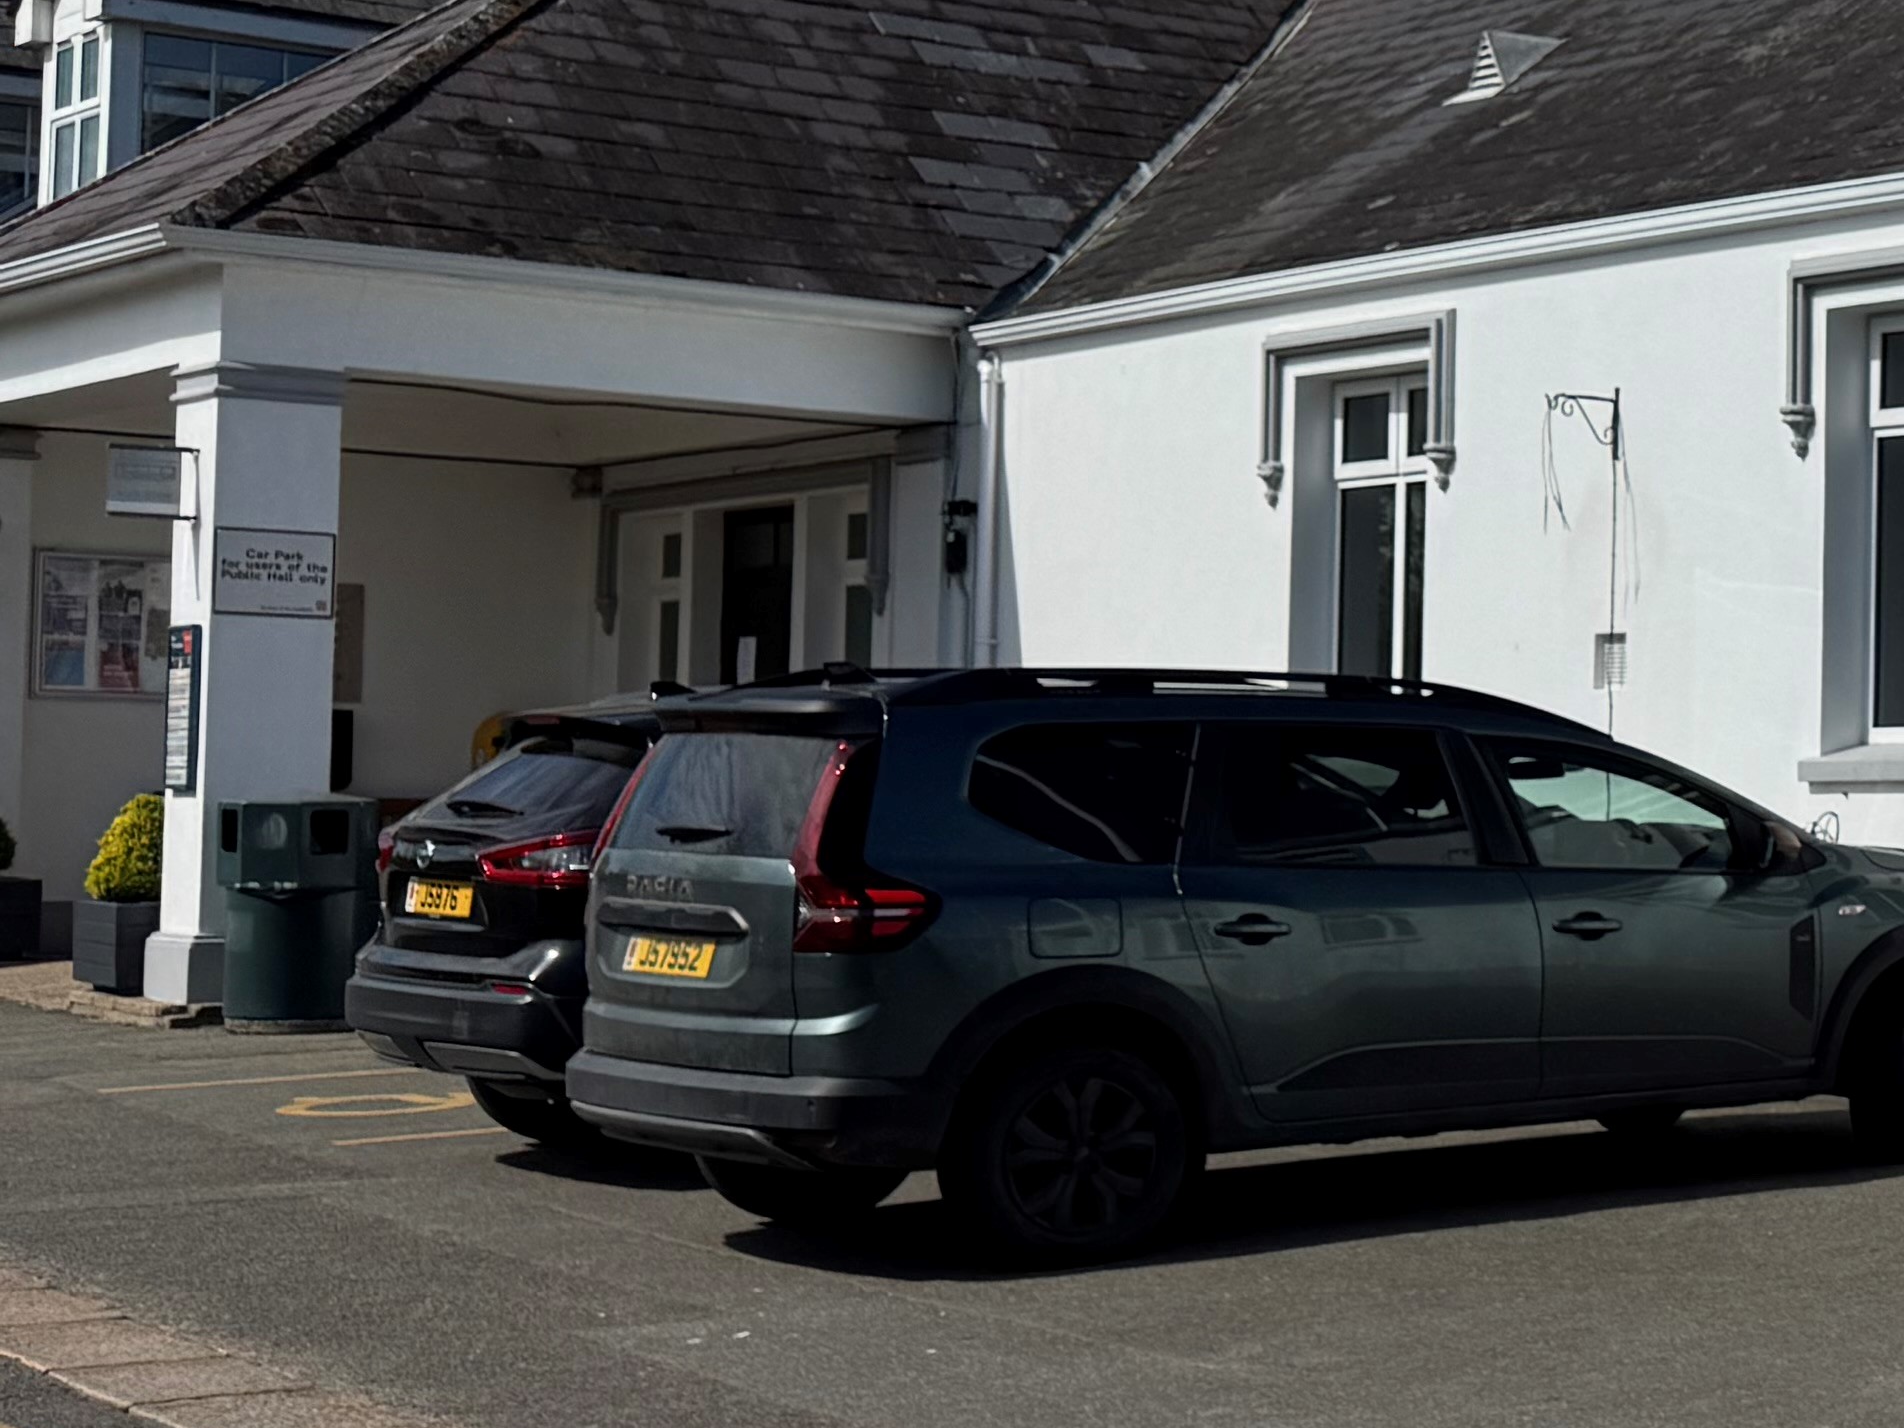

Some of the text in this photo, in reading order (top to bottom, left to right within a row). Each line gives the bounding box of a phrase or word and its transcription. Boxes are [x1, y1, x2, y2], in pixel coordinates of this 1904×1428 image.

[246, 548, 304, 561] Car Park
[221, 558, 328, 574] for users of the
[221, 569, 327, 586] Public Hall only
[626, 875, 695, 903] DACIA
